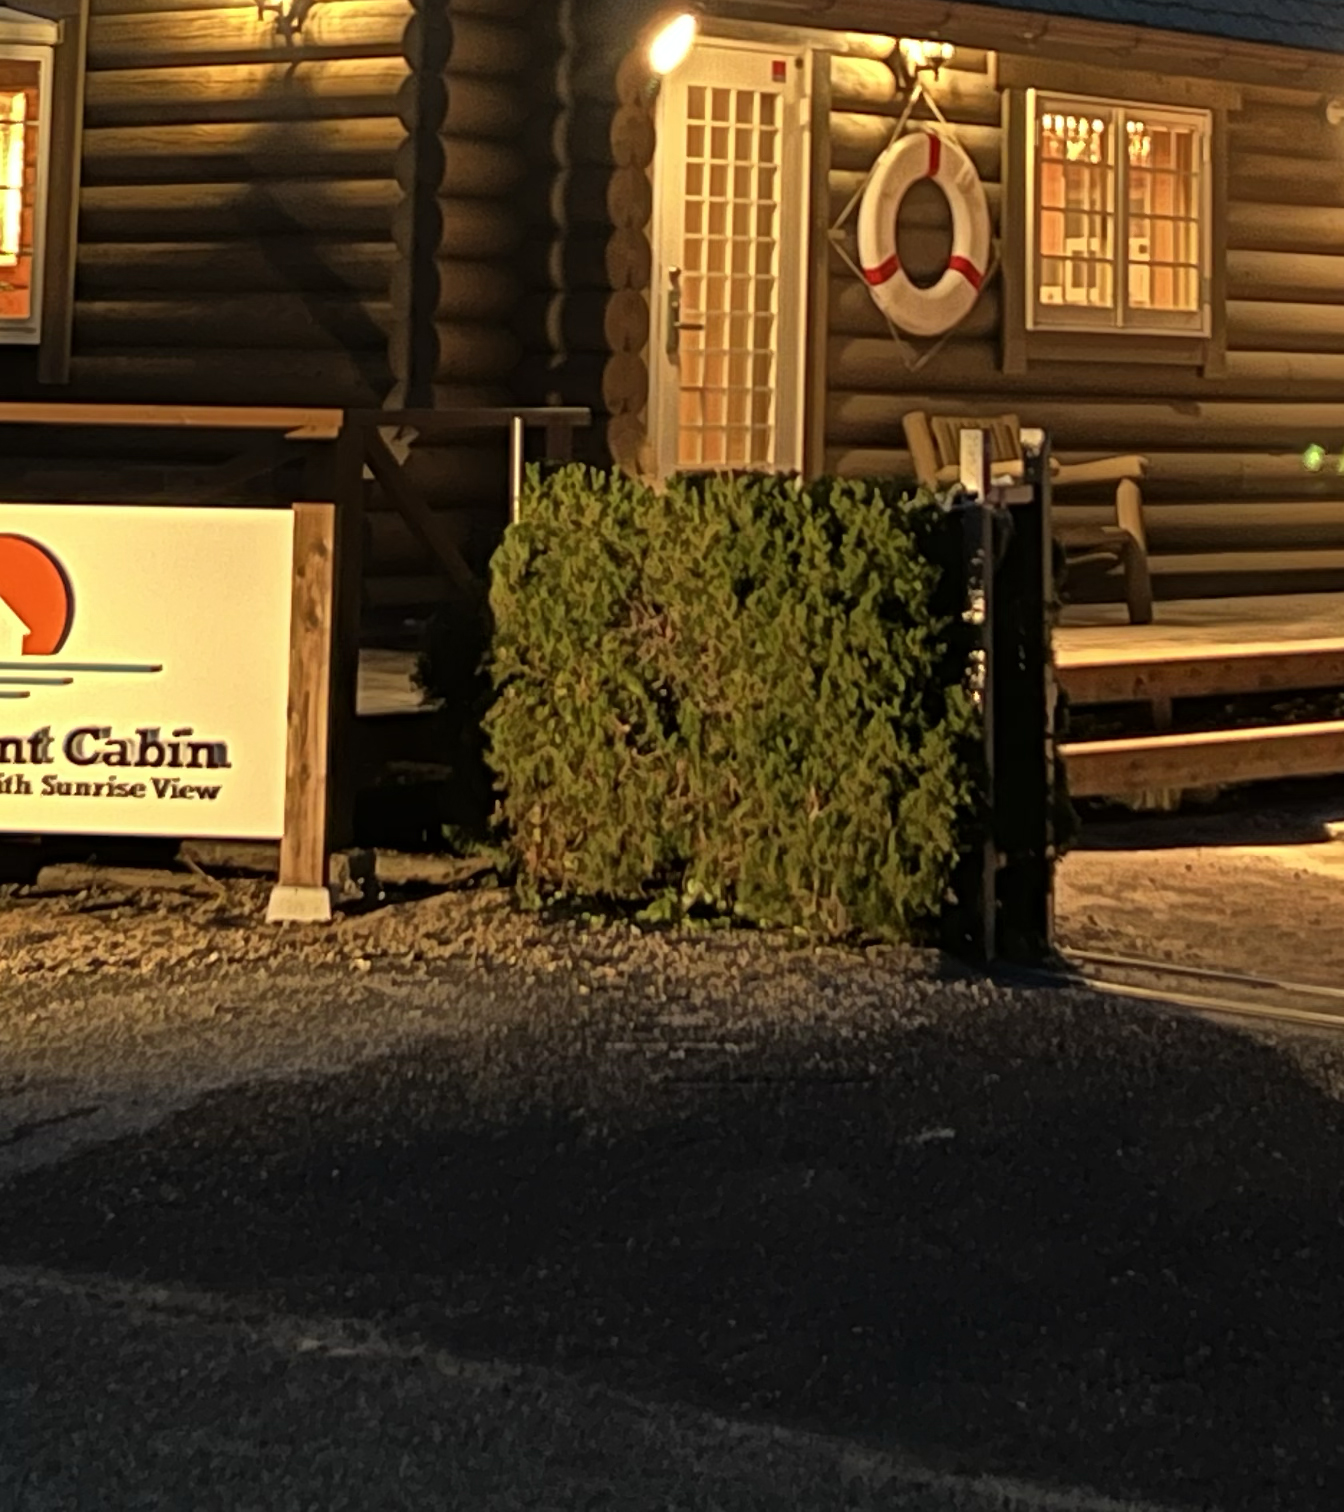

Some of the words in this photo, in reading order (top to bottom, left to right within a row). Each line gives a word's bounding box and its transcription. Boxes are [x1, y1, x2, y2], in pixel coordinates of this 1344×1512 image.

[63, 724, 233, 769] Cabin
[41, 774, 147, 799] Sunrise
[150, 777, 223, 801] View
